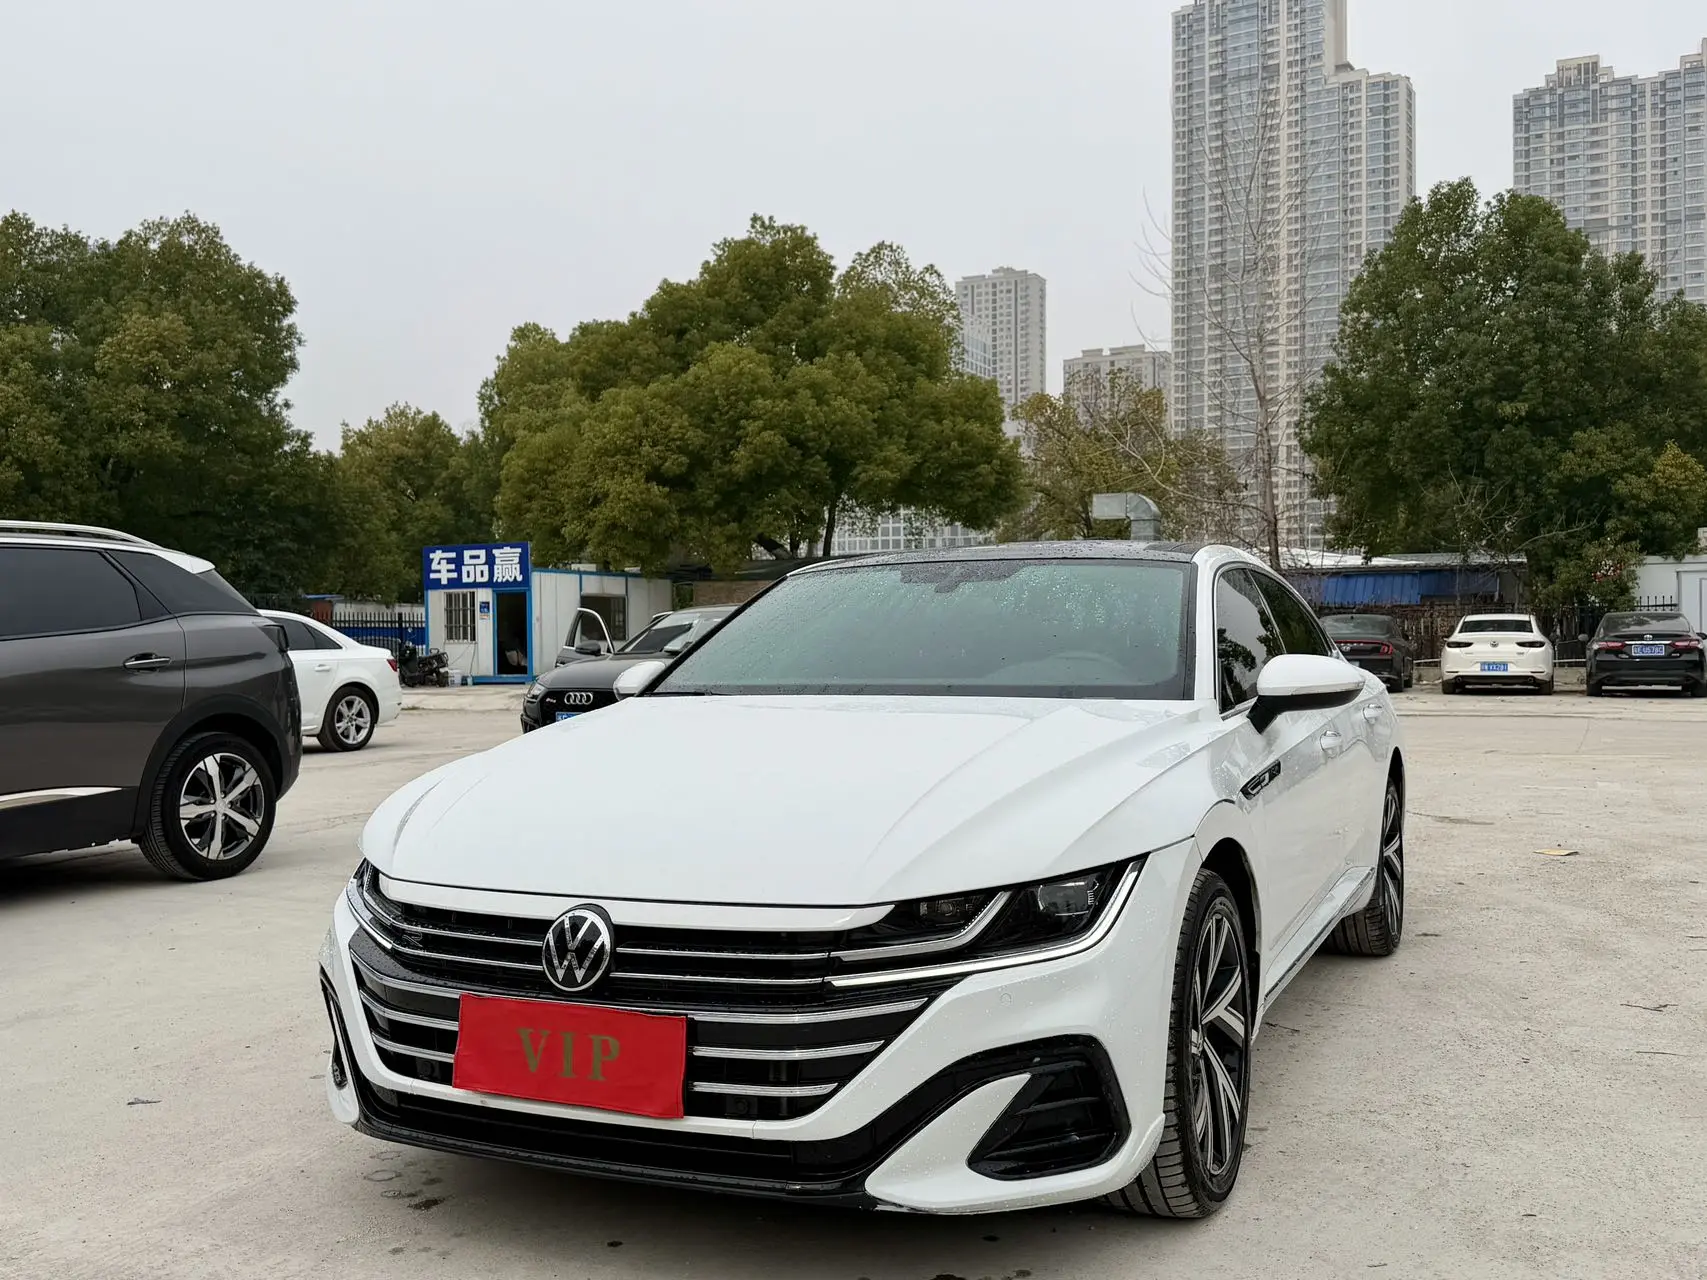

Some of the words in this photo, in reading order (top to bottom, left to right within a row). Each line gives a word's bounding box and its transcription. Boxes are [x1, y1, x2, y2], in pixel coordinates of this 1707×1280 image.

[429, 546, 523, 585] 车品赢
[517, 1027, 621, 1082] VIP
